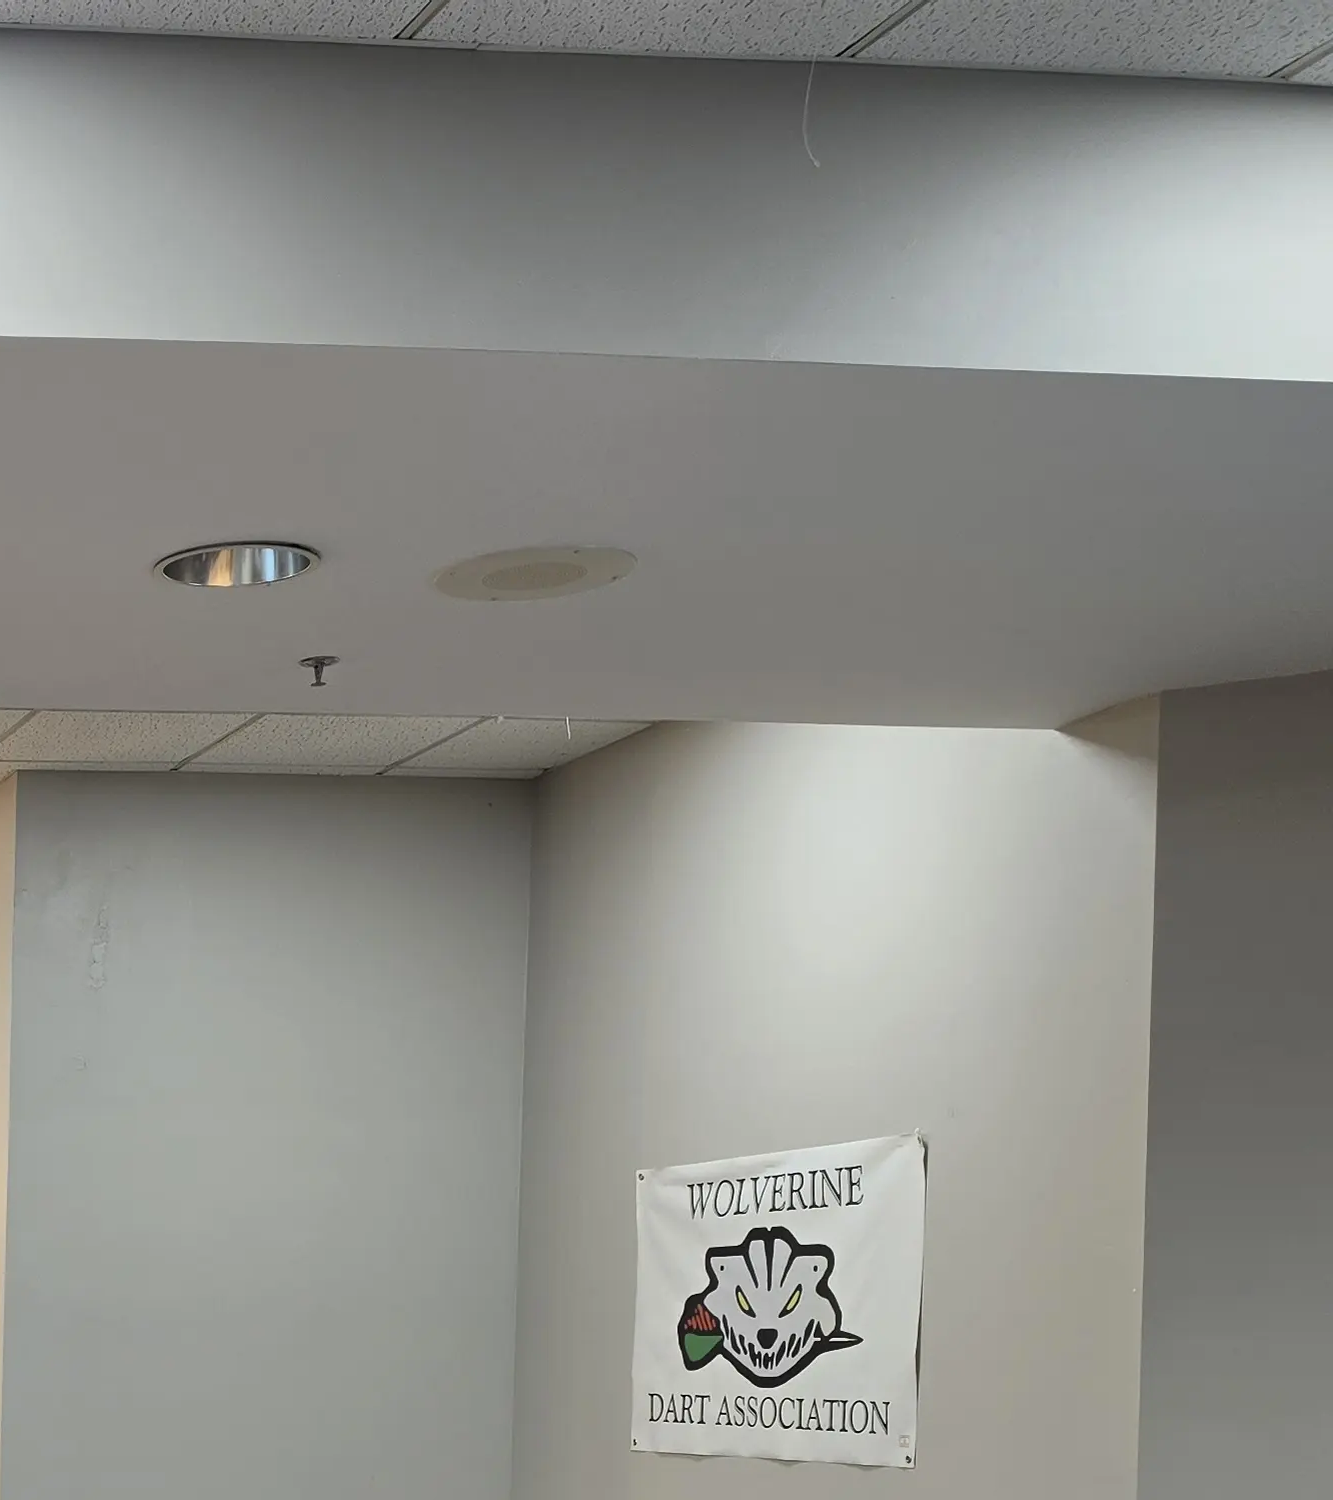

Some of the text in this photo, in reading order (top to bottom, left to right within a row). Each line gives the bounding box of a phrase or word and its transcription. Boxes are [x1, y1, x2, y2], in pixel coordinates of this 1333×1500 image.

[687, 1165, 864, 1220] WOLVERINE
[648, 1393, 890, 1435] DART ASSOCIATION
